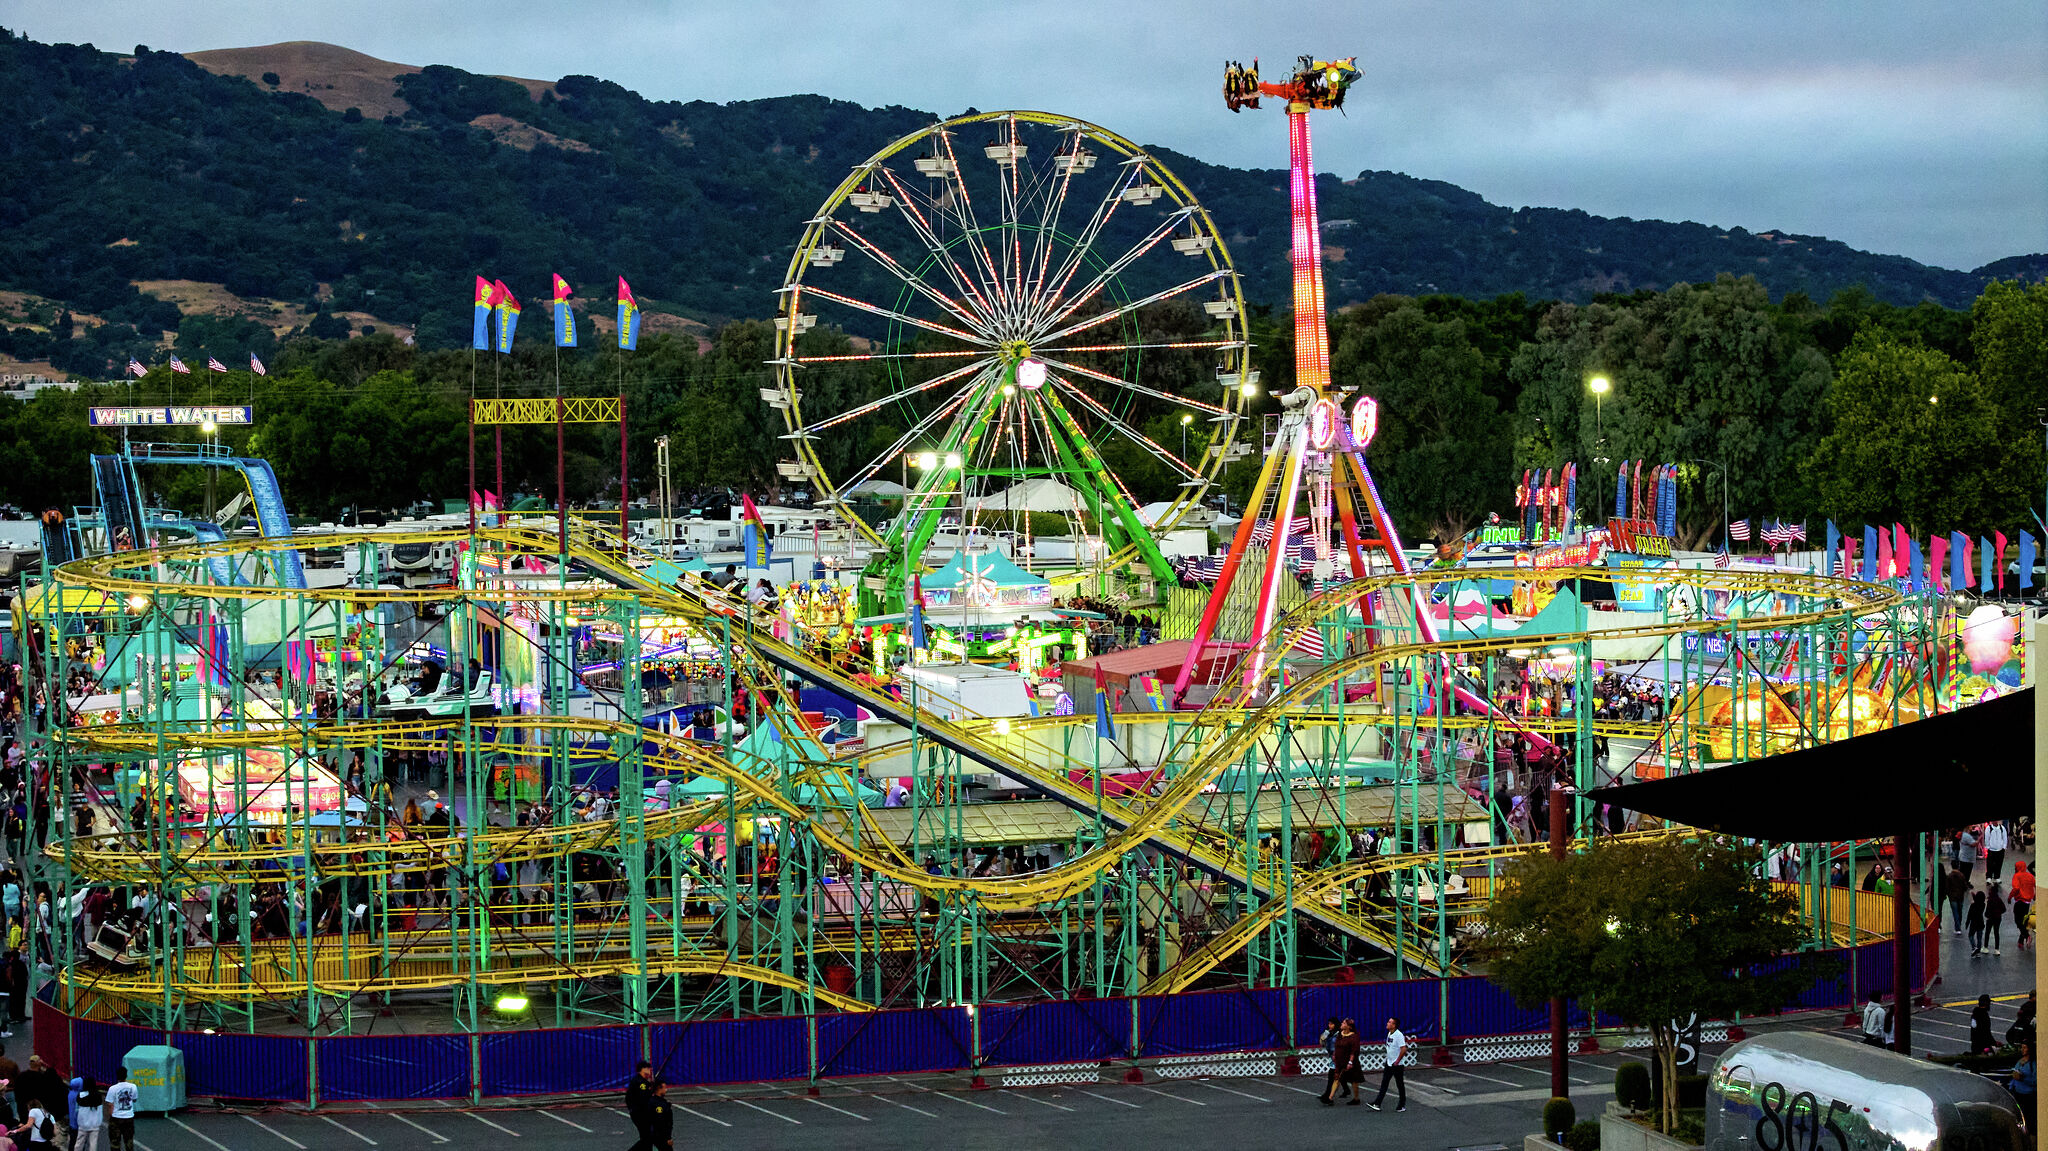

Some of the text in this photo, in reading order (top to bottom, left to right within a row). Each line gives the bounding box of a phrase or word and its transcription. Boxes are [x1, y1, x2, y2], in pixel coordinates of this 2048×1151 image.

[94, 407, 247, 424] WHITE WATER
[1608, 518, 1637, 552] BIG
[1636, 535, 1671, 557] PRIZES
[1620, 590, 1643, 601] STAR
[133, 1068, 157, 1077] HIGH
[1756, 1082, 1852, 1151] 805
